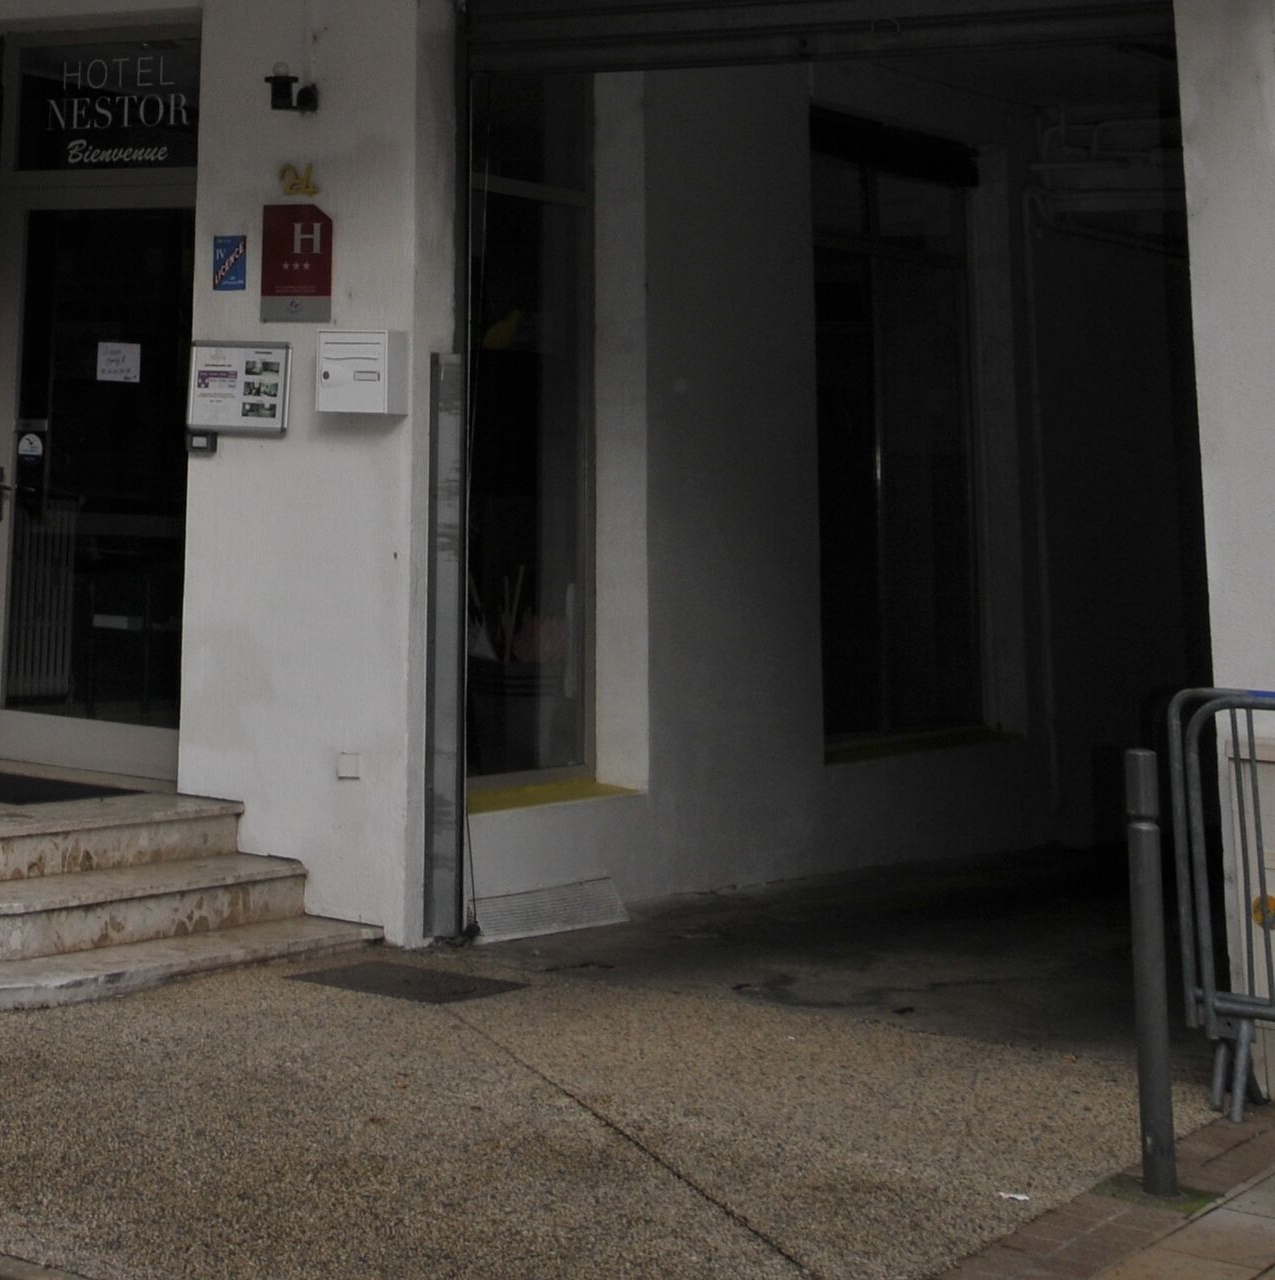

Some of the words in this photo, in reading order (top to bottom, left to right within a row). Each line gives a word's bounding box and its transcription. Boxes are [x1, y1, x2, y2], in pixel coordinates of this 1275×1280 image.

[62, 55, 176, 91] HOTEL
[45, 92, 190, 131] NESTOR
[66, 139, 169, 164] Bienvenue
[277, 161, 321, 197] 24
[292, 222, 325, 255] H
[214, 239, 244, 285] LICENCE
